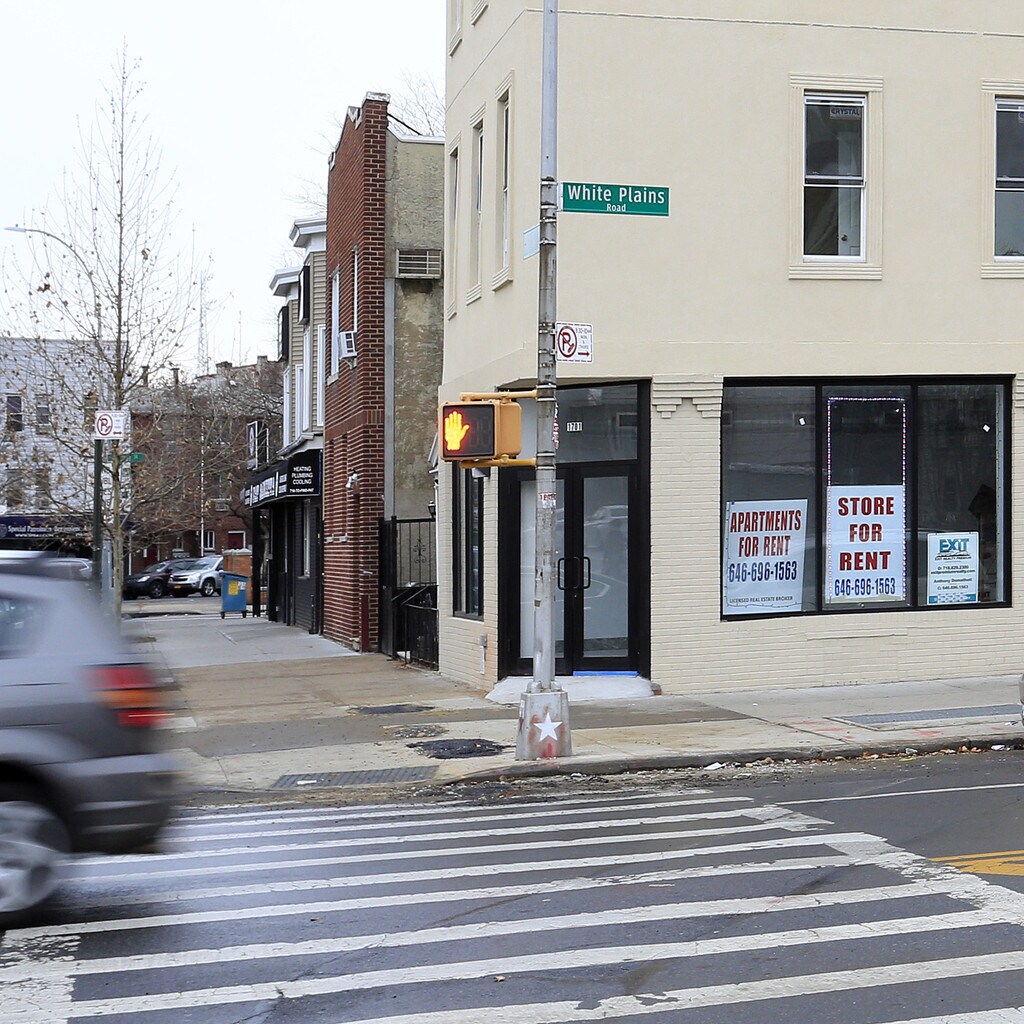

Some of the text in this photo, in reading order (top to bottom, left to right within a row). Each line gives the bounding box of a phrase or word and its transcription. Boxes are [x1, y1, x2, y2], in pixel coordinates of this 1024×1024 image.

[830, 107, 860, 116] CRYSTAL
[567, 184, 666, 204] White Plains
[606, 203, 627, 212] Road
[838, 497, 895, 516] STORE
[730, 509, 801, 532] APARTMENTS
[849, 523, 883, 543] FOR
[738, 535, 791, 558] FOR RENT
[939, 538, 970, 553] EXIT
[839, 551, 892, 571] RENT
[728, 561, 798, 583] 646-696-1563
[834, 577, 896, 597] 646-696-1563
